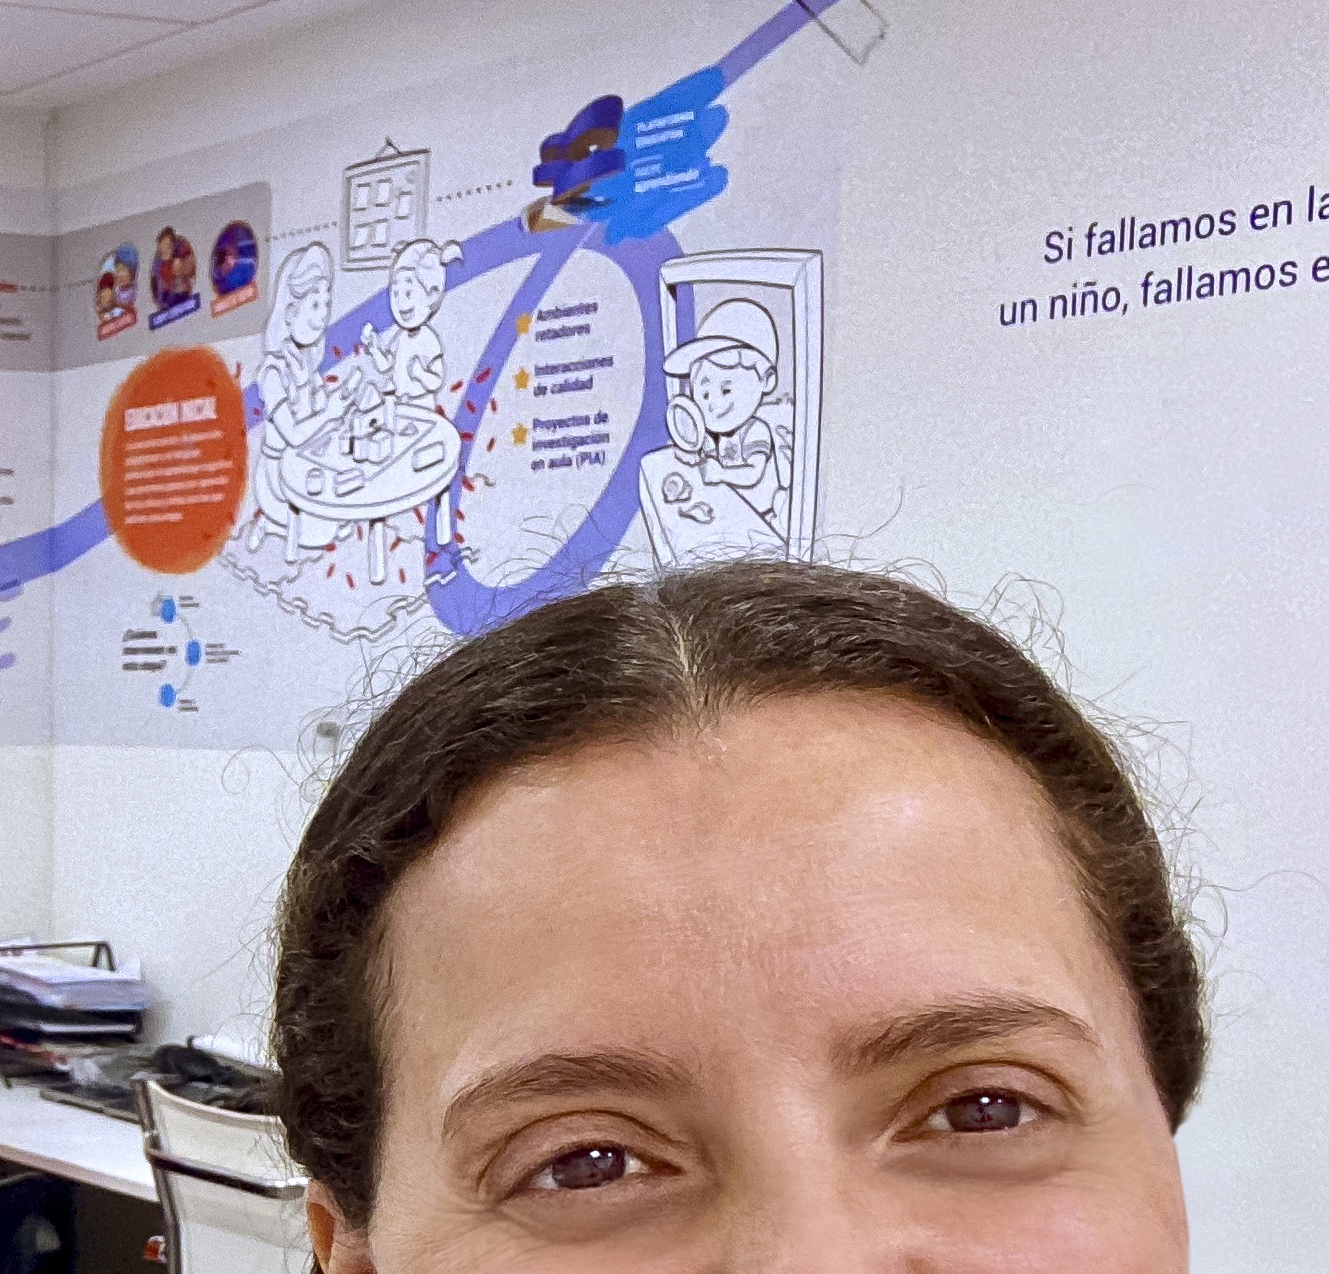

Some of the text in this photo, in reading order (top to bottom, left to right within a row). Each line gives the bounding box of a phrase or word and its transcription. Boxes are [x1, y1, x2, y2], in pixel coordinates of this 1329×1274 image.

[1044, 226, 1074, 264] Si
[1085, 209, 1237, 258] fallamos
[1250, 200, 1293, 231] en
[999, 298, 1038, 327] un
[1049, 280, 1129, 320] niño,
[1141, 260, 1299, 308] fallamos
